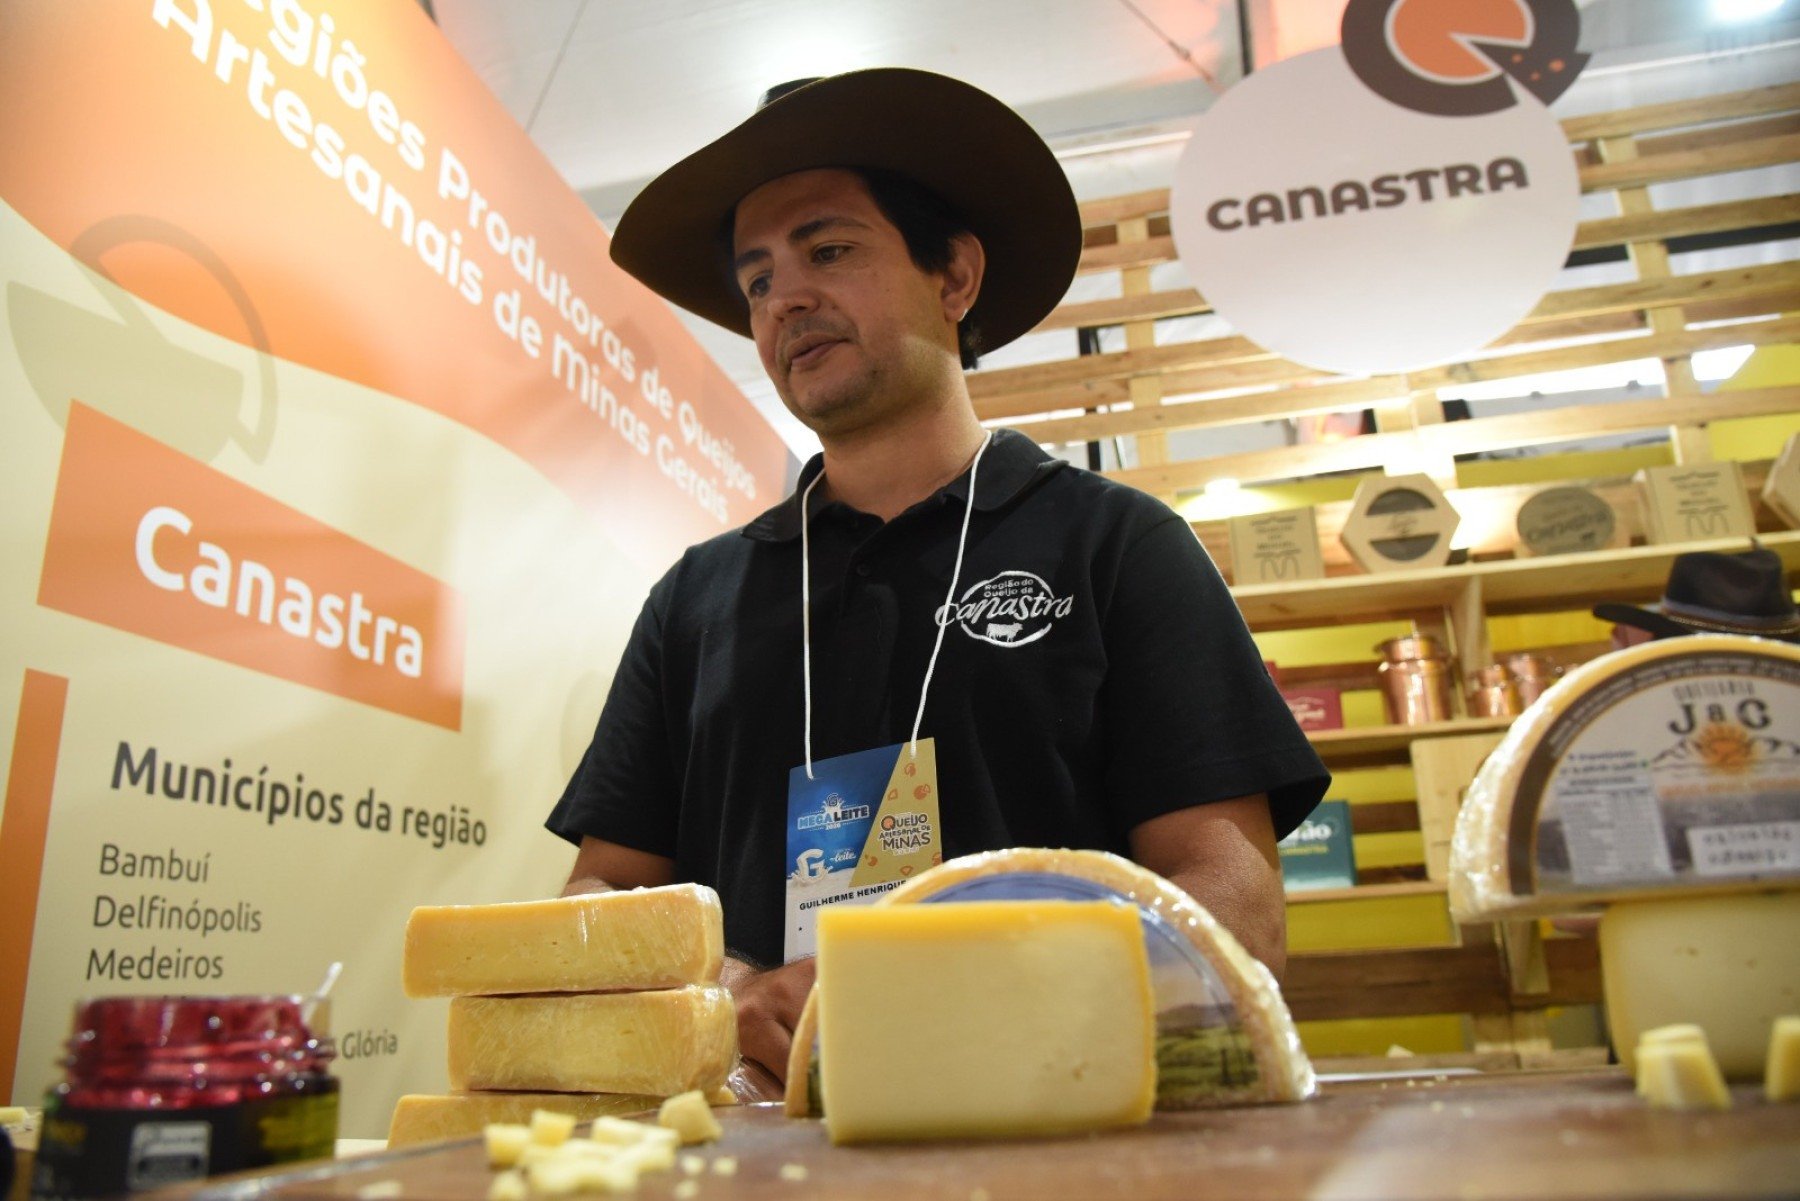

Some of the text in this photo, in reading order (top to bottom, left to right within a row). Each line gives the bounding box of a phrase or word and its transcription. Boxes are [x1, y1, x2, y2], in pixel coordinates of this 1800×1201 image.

[1206, 156, 1529, 232] CANASTRA
[151, 0, 729, 524] Artesanais de Minas Gerais
[244, 0, 757, 500] giões Produtoras de Queijos
[135, 505, 424, 679] Canastra
[983, 586, 1034, 597] Queijo da
[984, 578, 1034, 590] Região do
[934, 591, 1074, 627] Canastra
[110, 740, 488, 849] Municípios da região
[881, 813, 928, 831] QUEIJO
[99, 843, 212, 884] Bambuí
[93, 895, 263, 938] Delfinópolis
[799, 892, 855, 911] GUILHERME
[86, 946, 224, 981] Medeiros
[341, 1028, 398, 1061] Glória
